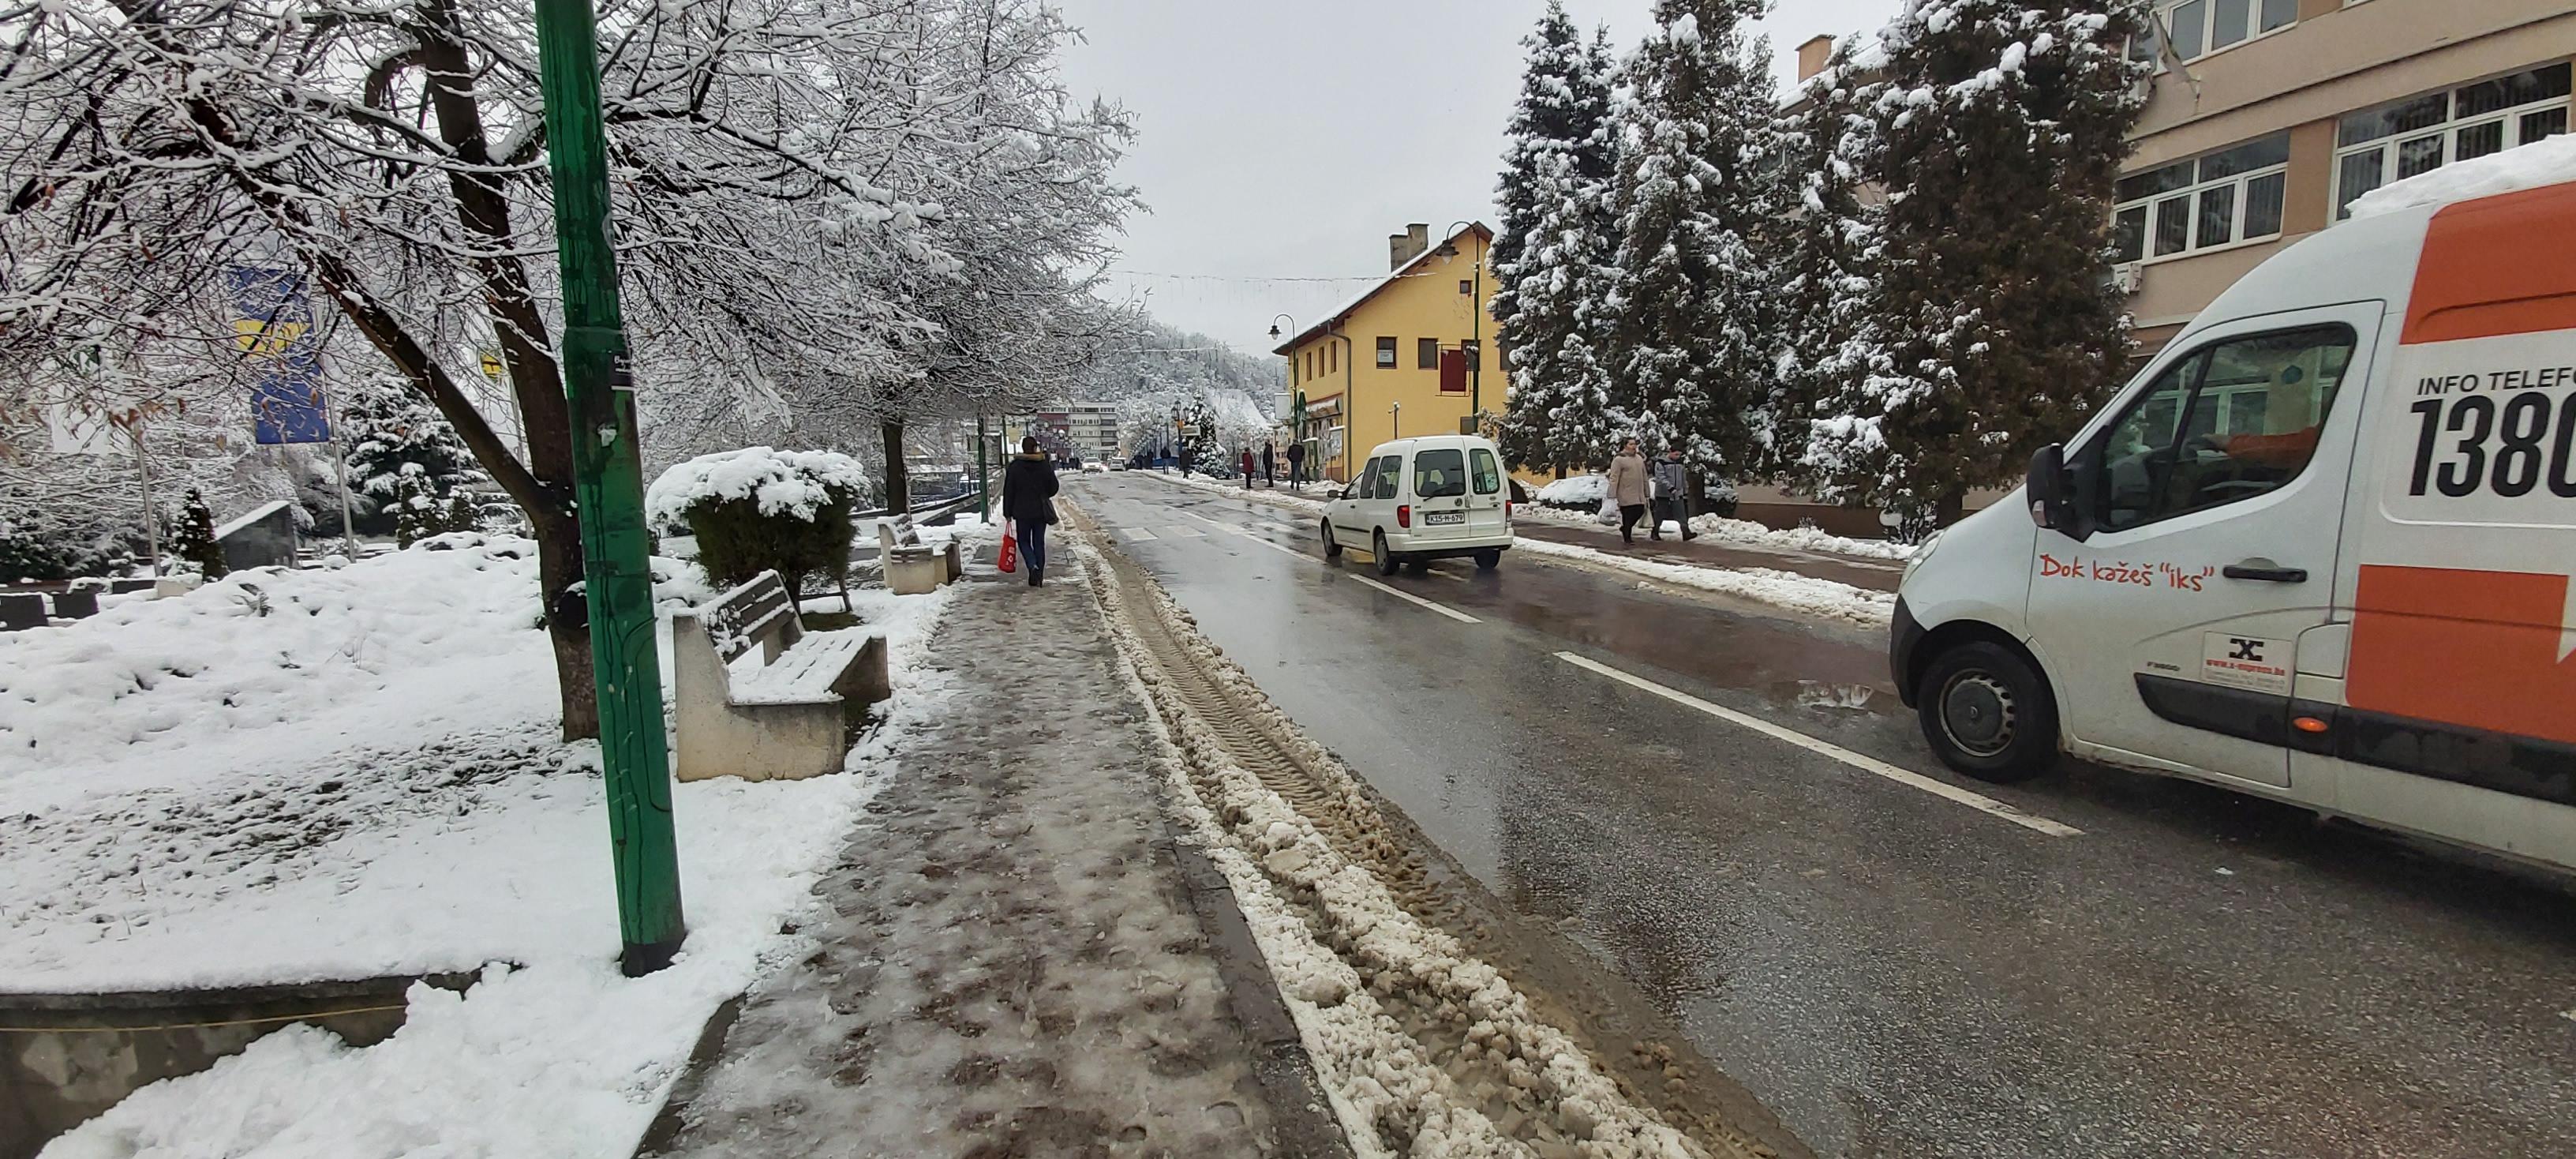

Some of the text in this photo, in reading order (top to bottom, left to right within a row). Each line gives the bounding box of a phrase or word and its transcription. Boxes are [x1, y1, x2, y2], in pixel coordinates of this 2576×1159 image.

[2416, 366, 2576, 396] INFO TELEF
[2039, 553, 2086, 578] Dok
[2093, 560, 2154, 587] kažeš
